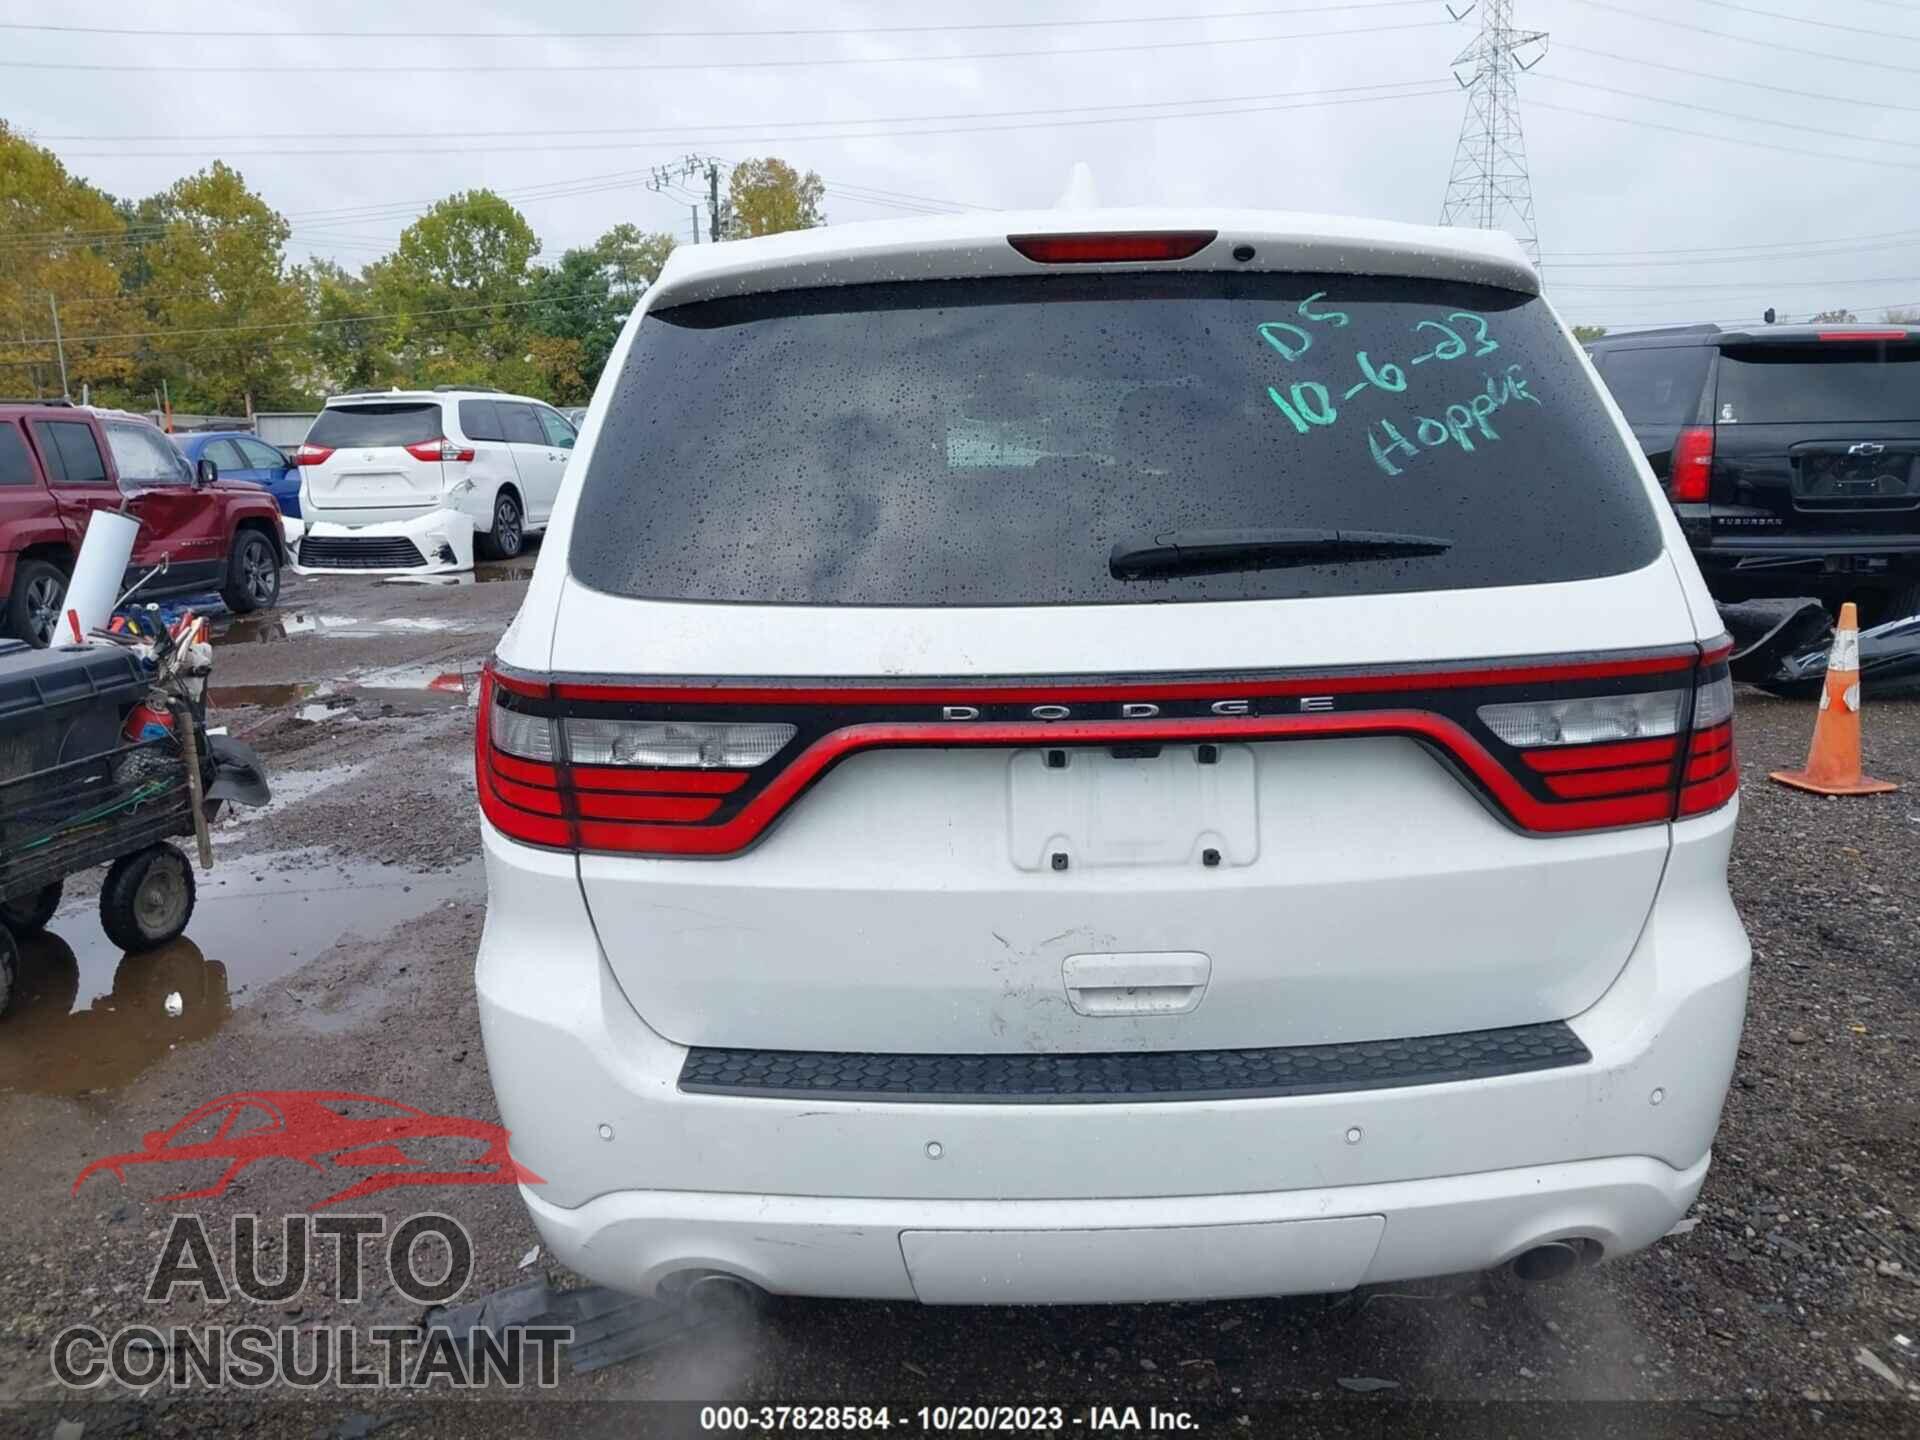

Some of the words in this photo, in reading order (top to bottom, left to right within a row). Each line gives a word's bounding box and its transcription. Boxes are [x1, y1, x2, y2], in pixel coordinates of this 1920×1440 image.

[1256, 291, 1350, 362] DS
[1266, 311, 1500, 434] 10-6-23
[943, 696, 1335, 721] DODGE
